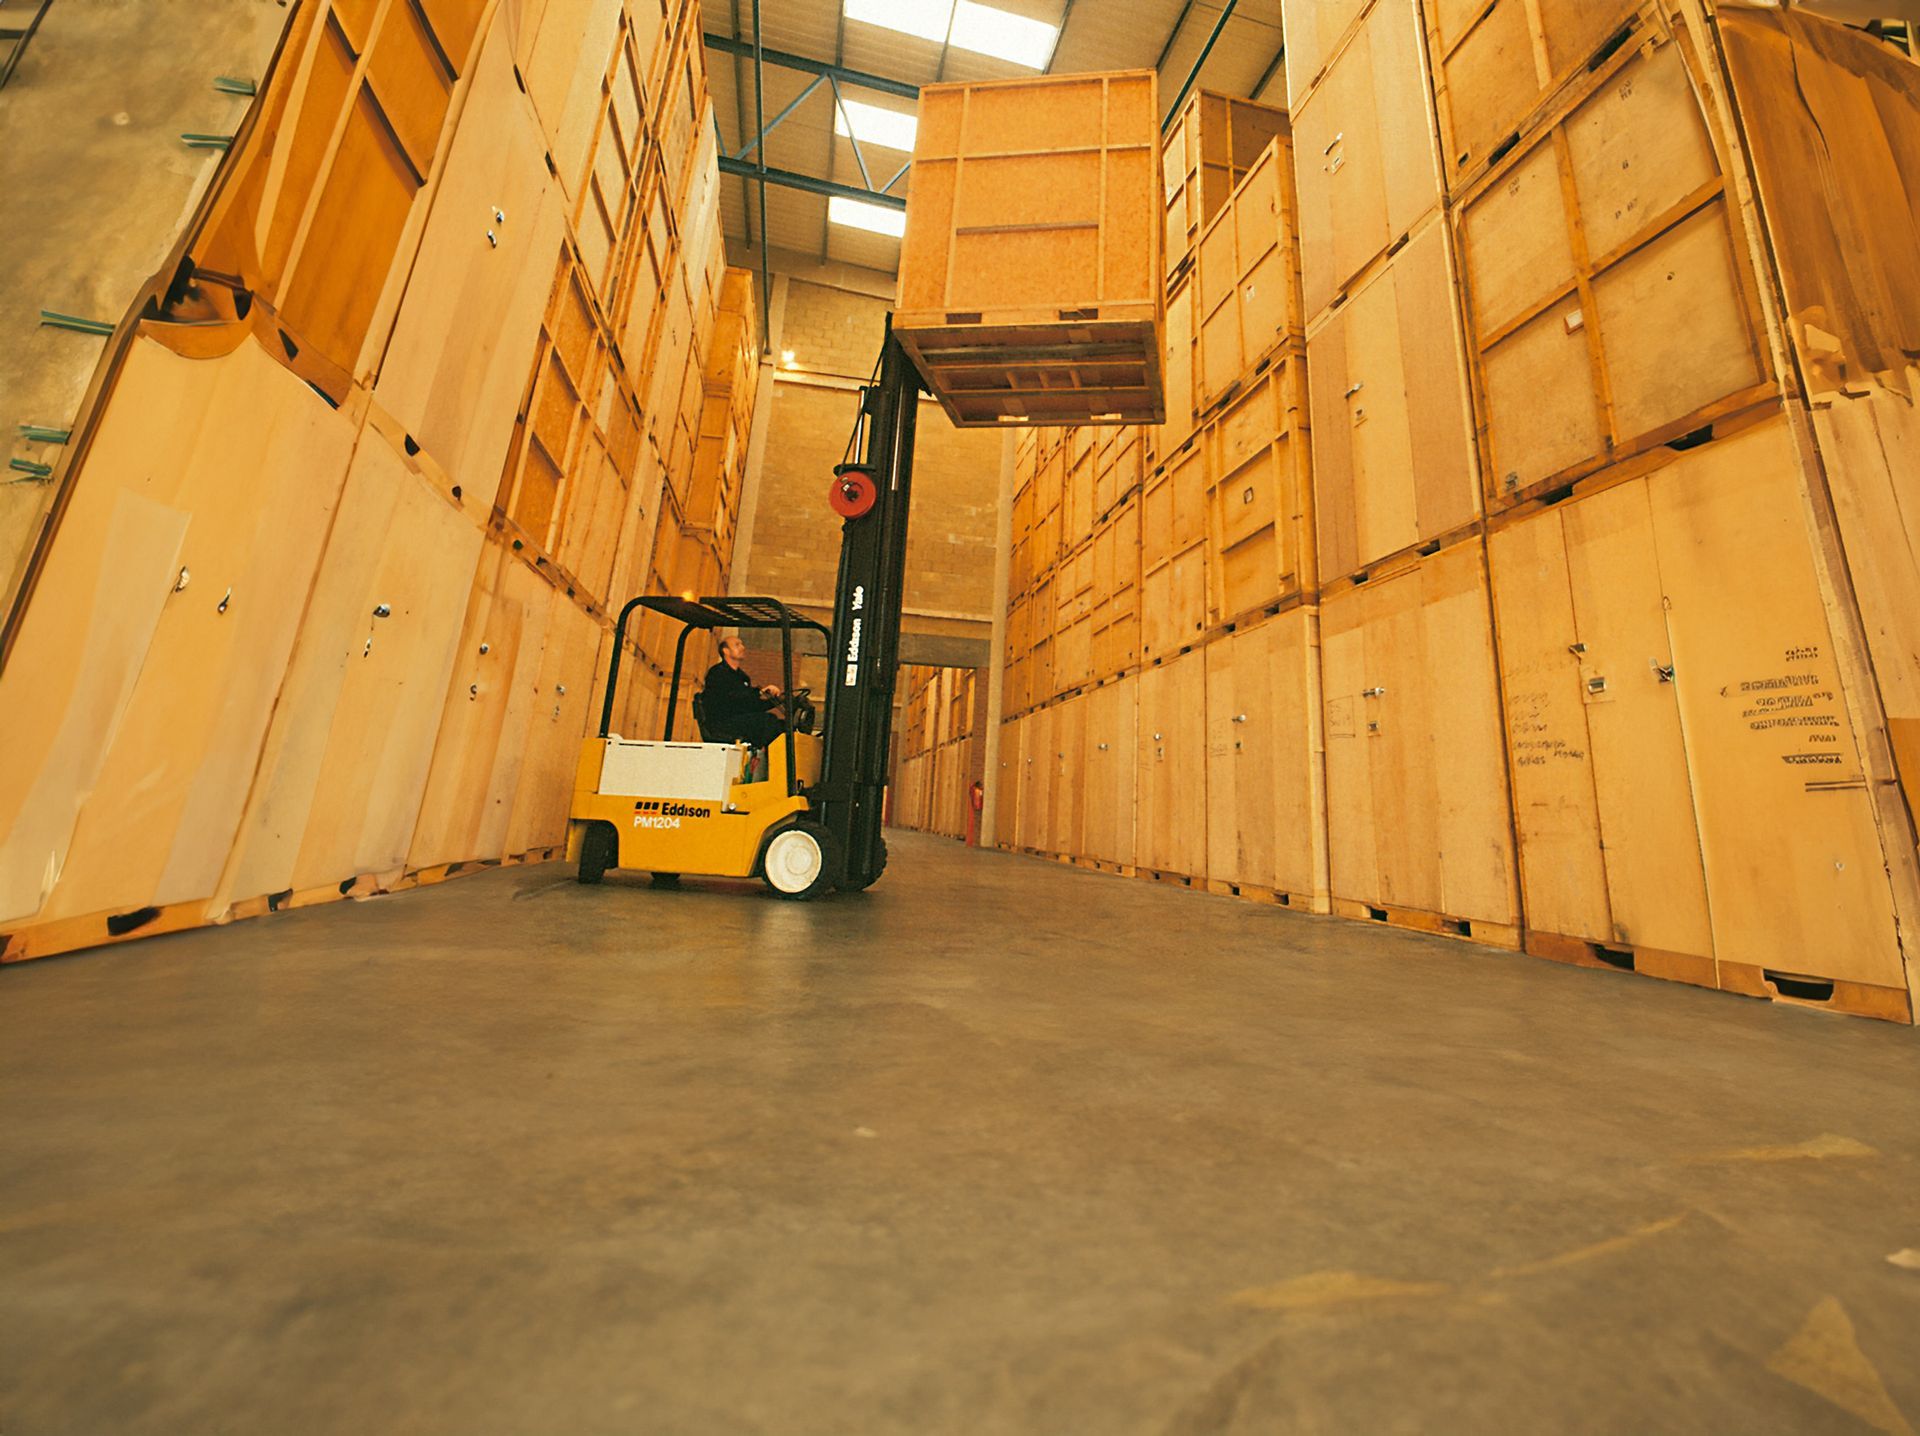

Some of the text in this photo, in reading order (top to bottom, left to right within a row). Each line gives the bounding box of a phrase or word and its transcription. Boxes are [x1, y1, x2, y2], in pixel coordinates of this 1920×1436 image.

[846, 618, 862, 662] Eddison
[661, 802, 711, 818] Eddison
[633, 815, 681, 829] PM1204
